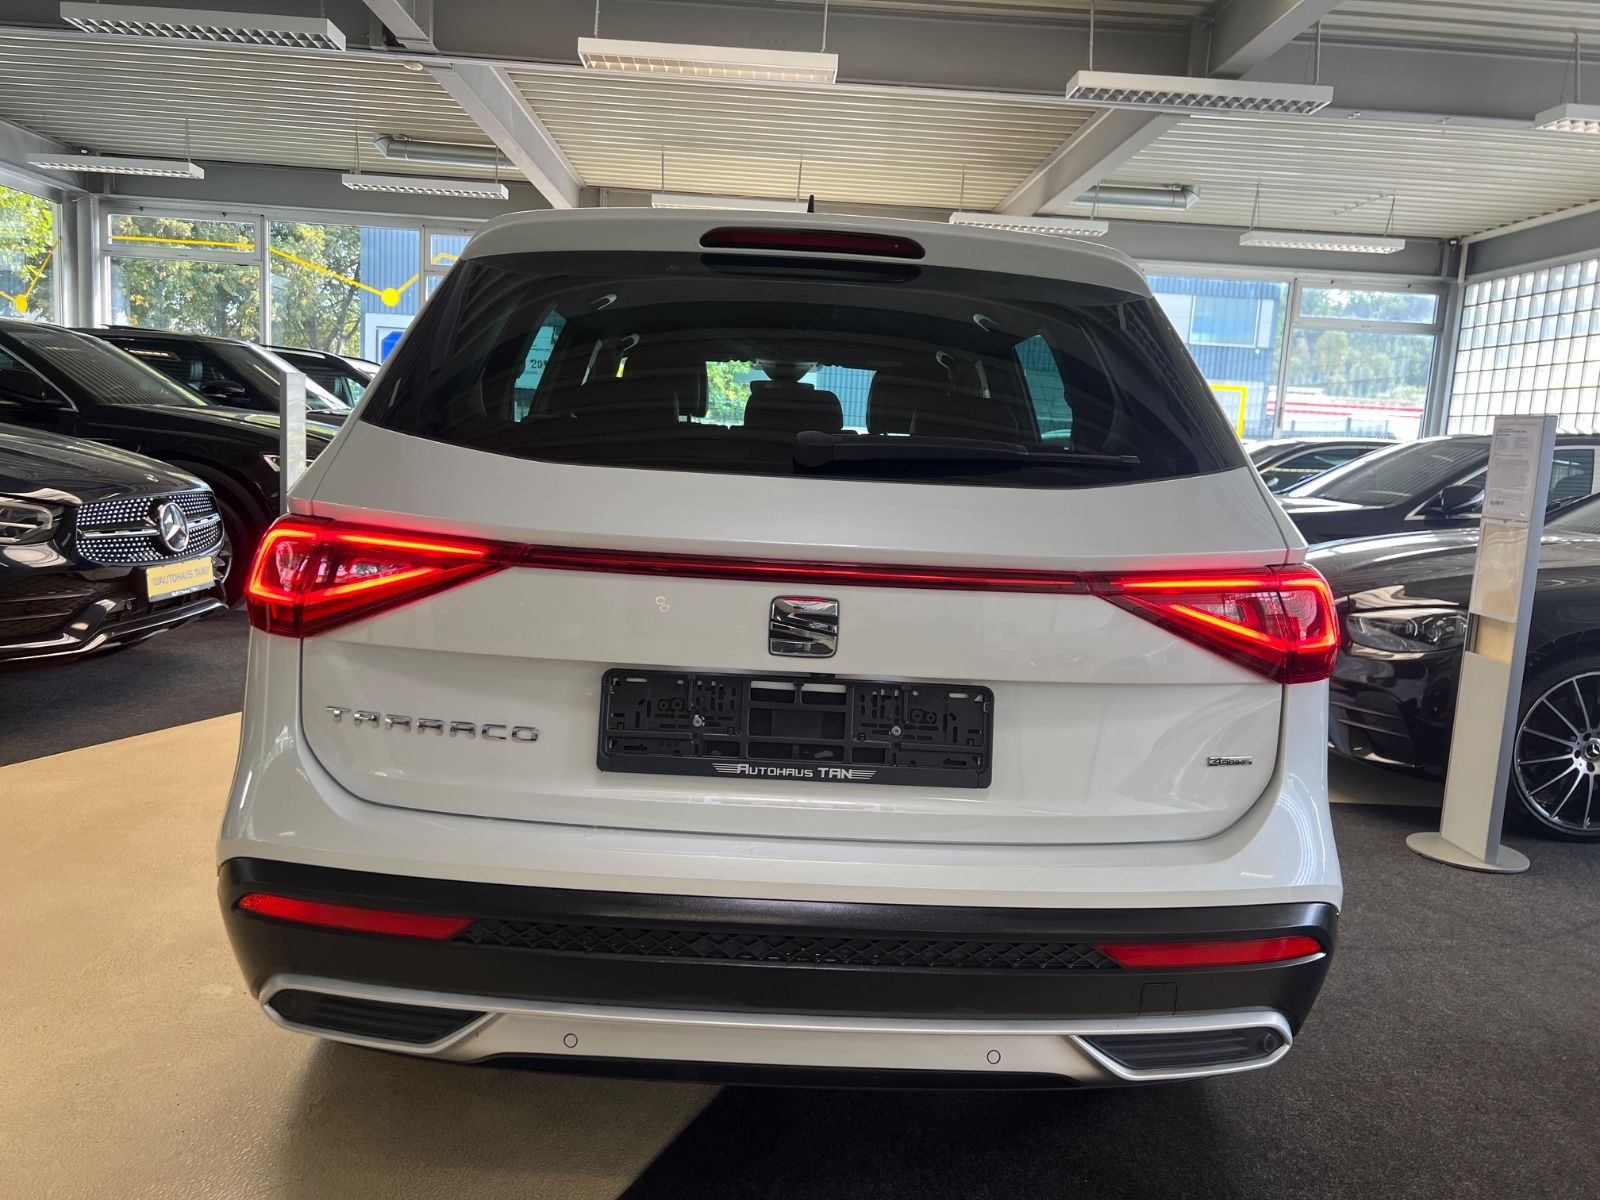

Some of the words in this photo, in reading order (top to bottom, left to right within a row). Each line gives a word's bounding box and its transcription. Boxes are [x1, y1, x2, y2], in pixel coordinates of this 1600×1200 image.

[158, 569, 193, 585] AUTOHAUS
[325, 705, 540, 743] TARRACO
[736, 763, 814, 778] AUTOHAUS
[817, 767, 852, 780] TAN
